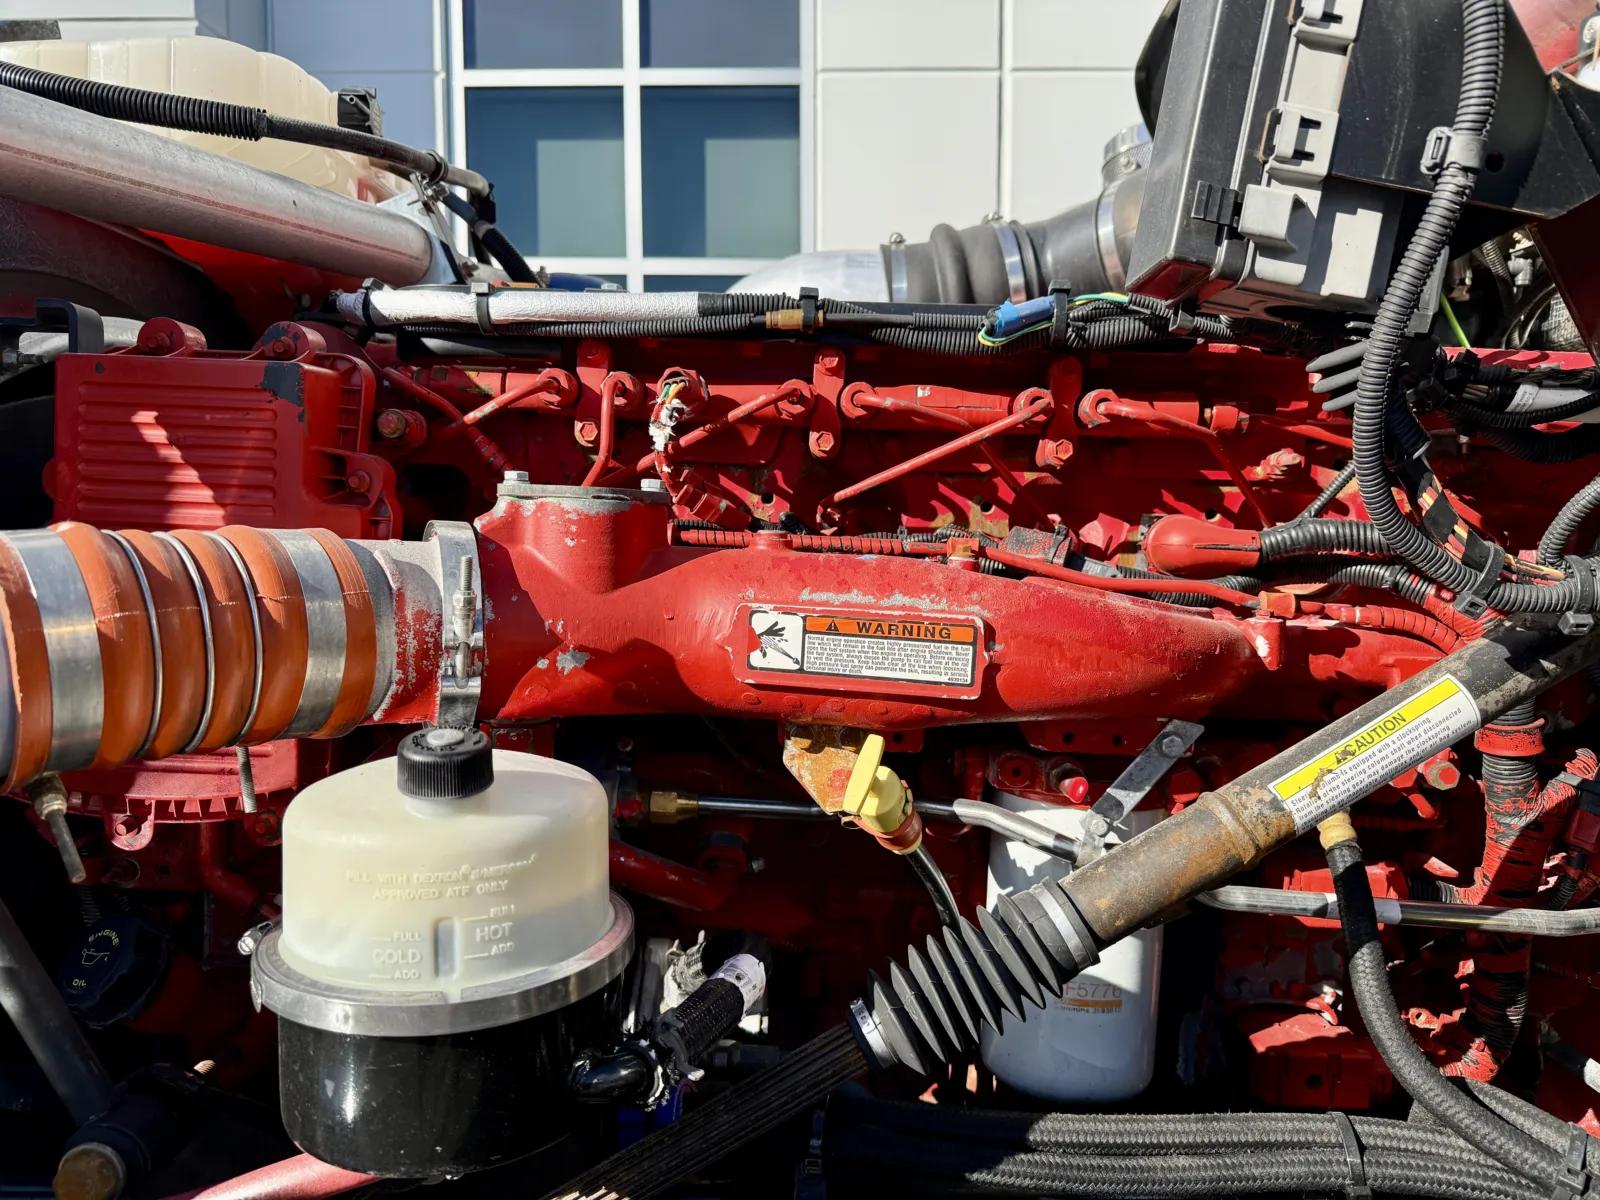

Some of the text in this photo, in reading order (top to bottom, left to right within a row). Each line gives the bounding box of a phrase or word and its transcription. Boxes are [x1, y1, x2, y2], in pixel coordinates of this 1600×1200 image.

[857, 621, 952, 640] WARNING
[1342, 712, 1407, 757] CAUTION
[1339, 767, 1348, 776] is
[1347, 749, 1377, 772] equipped
[1375, 741, 1391, 754] with
[1395, 715, 1433, 742] clockspring.
[1294, 794, 1322, 814] Rotatio
[1321, 789, 1329, 797] of
[1329, 782, 1340, 792] the
[1339, 766, 1367, 787] steering
[1366, 752, 1389, 769] column
[1389, 742, 1406, 755] shaft
[1405, 731, 1422, 745] when
[1422, 707, 1462, 735] disconnected
[377, 871, 409, 886] WITH
[373, 880, 509, 902] APPROVED ATF ONLY
[489, 904, 516, 917] FULL
[393, 931, 422, 942] FULL
[475, 922, 513, 942] HOT
[372, 948, 423, 964] COLD
[490, 942, 515, 956] ADD
[393, 969, 420, 980] ADD
[72, 979, 87, 987] OIL
